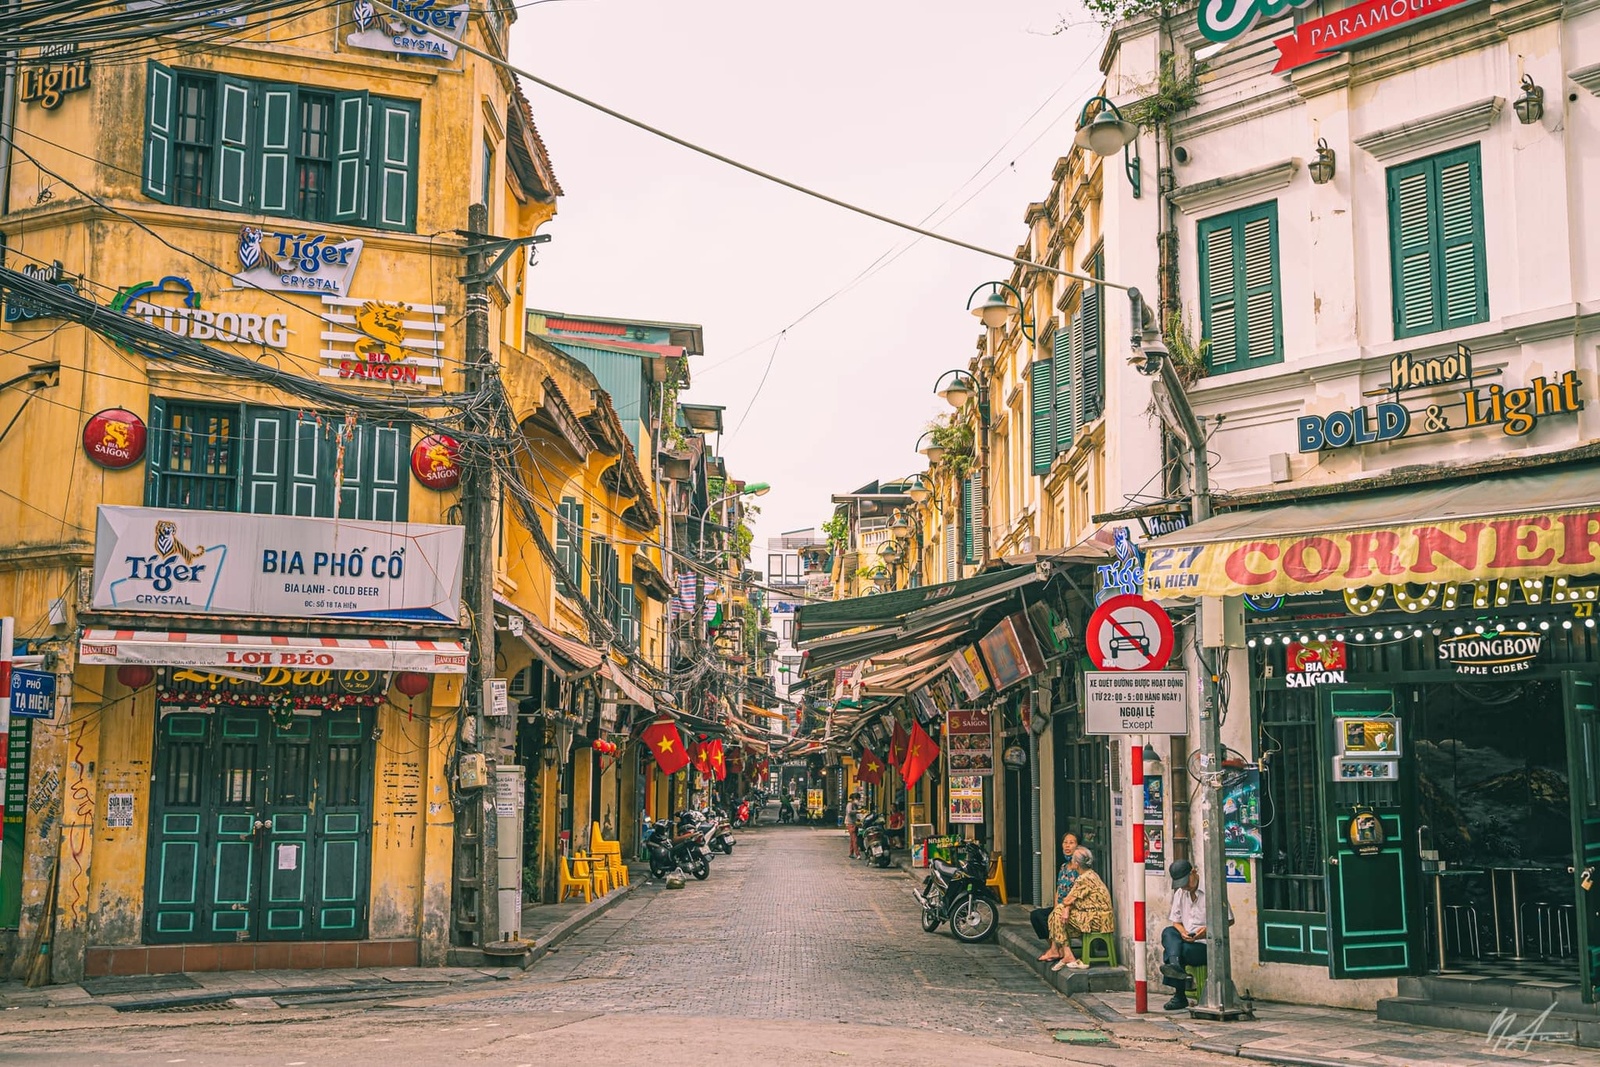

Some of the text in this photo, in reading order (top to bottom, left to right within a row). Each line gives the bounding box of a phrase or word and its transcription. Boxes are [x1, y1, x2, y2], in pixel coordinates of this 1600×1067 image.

[1311, 0, 1443, 46] PARAMOU
[393, 36, 448, 54] CRYSTAL
[22, 60, 89, 109] Light
[273, 232, 354, 274] Tiger
[281, 274, 340, 290] CRYSTAL
[136, 301, 288, 348] TUBORG
[368, 352, 391, 364] BIA
[339, 361, 418, 382] SAIGON
[1391, 345, 1469, 389] Hanoi
[1298, 371, 1582, 452] BOLD & Light
[95, 444, 129, 459] SAIGON
[426, 469, 458, 480] SAIGON
[263, 546, 405, 579] BIA PHỐ CỔ
[1148, 546, 1204, 571] 27
[125, 555, 206, 592] Tiger
[1097, 558, 1145, 595] Tige
[1147, 571, 1199, 592] TẠ HIỆN
[284, 583, 299, 593] BIA
[302, 584, 325, 596] LẠNH
[333, 585, 355, 596] COLD
[358, 587, 379, 597] BEER
[136, 594, 191, 605] CRYSTAL
[1572, 602, 1594, 617] 27
[1438, 637, 1542, 659] STRONGBOW
[280, 650, 334, 665] BÉO
[452, 655, 465, 665] BEER
[1305, 661, 1325, 672] BIA
[1456, 661, 1529, 674] APPLE CIDERS
[25, 678, 41, 690] PHỐ
[1090, 679, 1097, 687] XE
[1098, 676, 1112, 688] QUÉT
[1113, 676, 1133, 688] ĐƯỜNG
[1151, 679, 1166, 689] HOẠT
[1167, 676, 1183, 688] ĐỘNG
[1286, 671, 1346, 688] SAIGON
[15, 691, 50, 715] TẠ HIỆN
[1144, 691, 1160, 701] HÀNG
[1120, 704, 1155, 718] NGOẠI LỆ
[1122, 720, 1153, 730] Except
